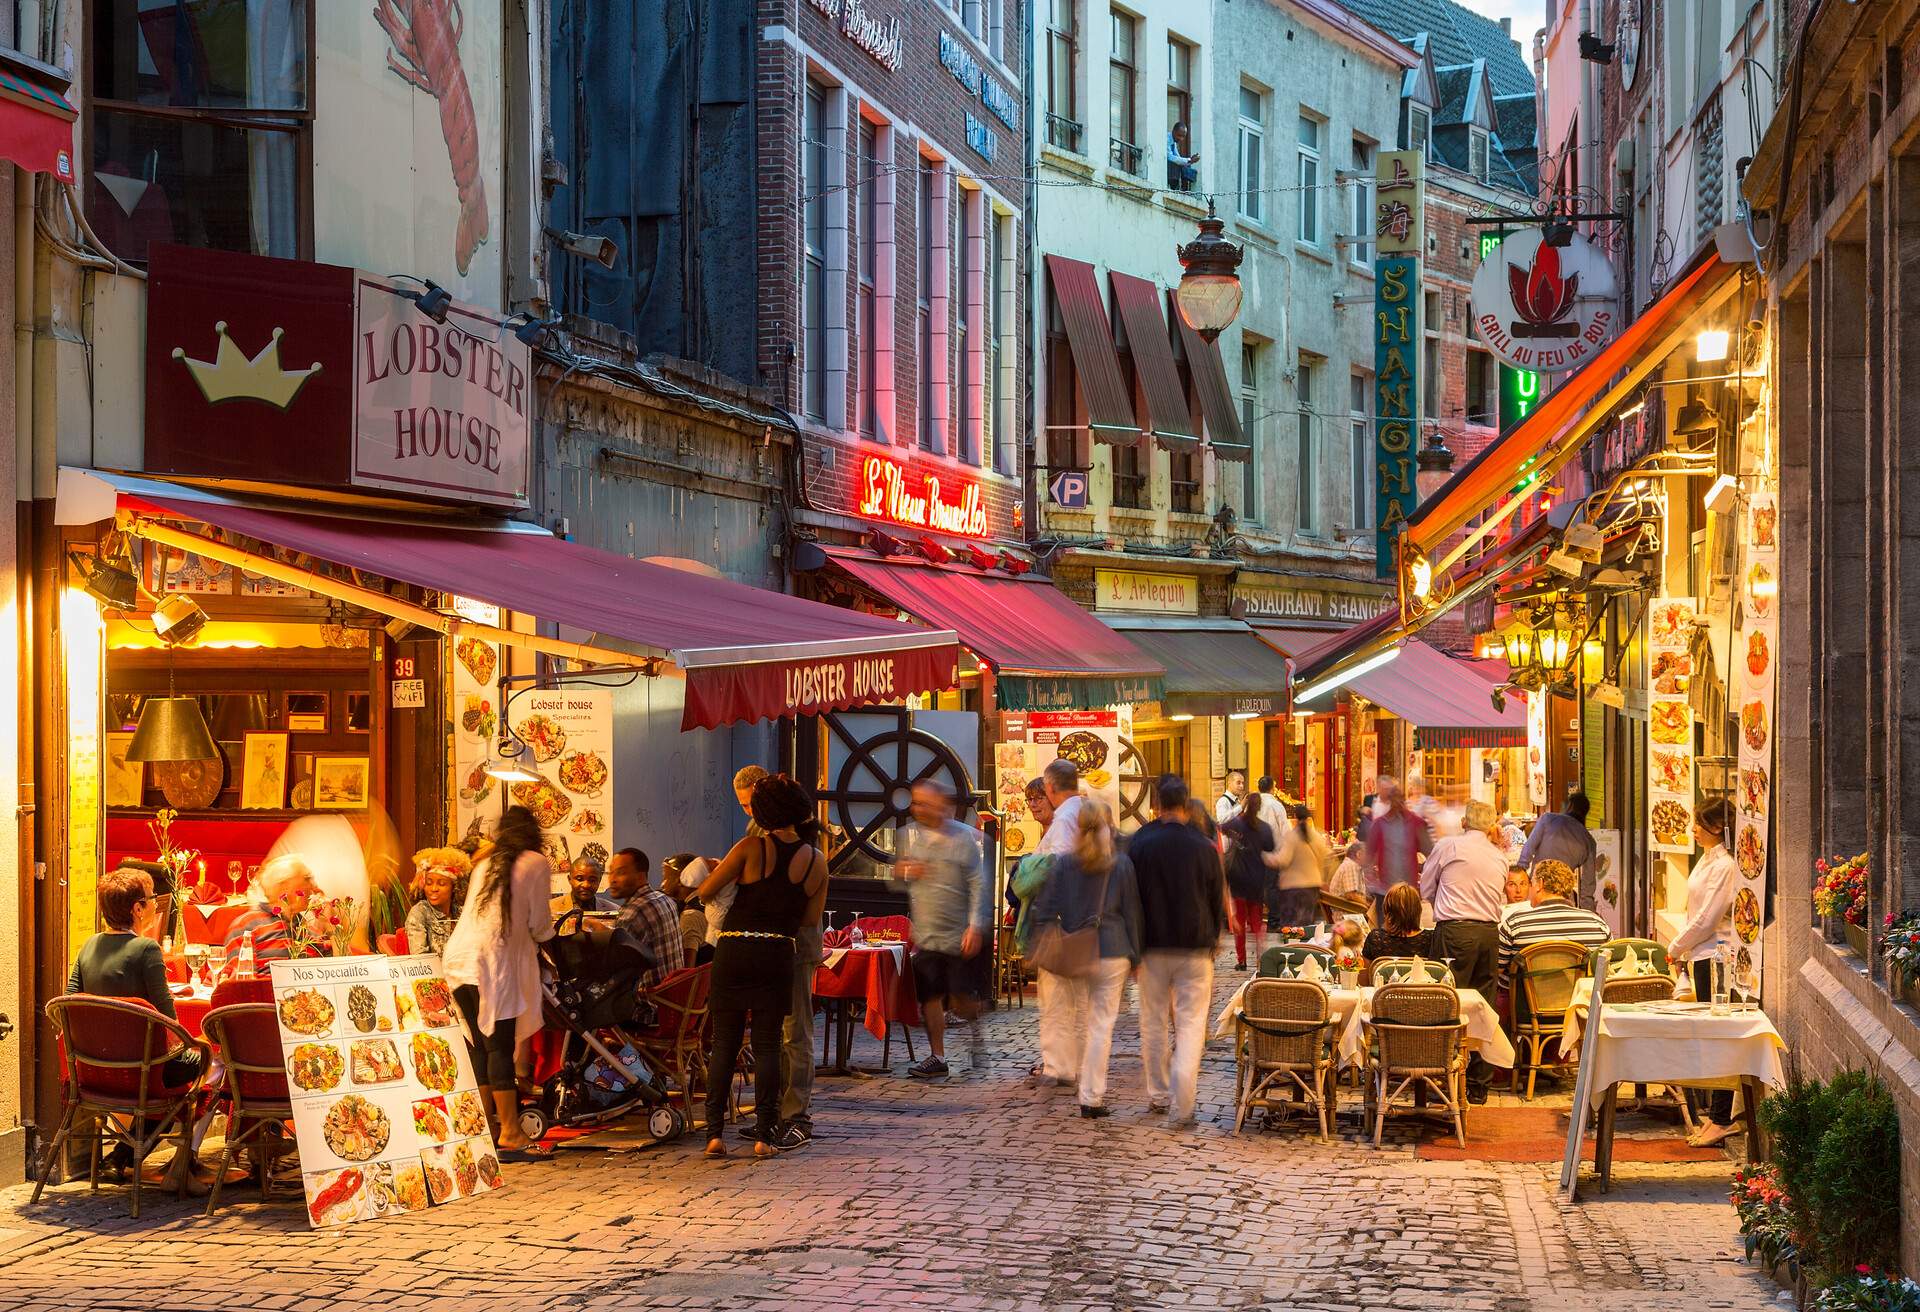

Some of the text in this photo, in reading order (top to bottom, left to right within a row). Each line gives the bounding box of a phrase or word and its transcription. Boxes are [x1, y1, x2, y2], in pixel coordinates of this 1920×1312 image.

[1377, 158, 1416, 243] 上海
[1480, 311, 1611, 367] GRILL AU FEU DE BOIS
[363, 323, 525, 417] LOBSTER
[394, 406, 501, 475] HOUSE
[860, 456, 884, 516] Le
[1063, 478, 1084, 504] P
[394, 681, 423, 691] FREE
[395, 658, 414, 677] 39
[785, 658, 895, 708] LOBSTER HOUSE
[531, 698, 563, 710] Lobster
[292, 967, 314, 981] Nos
[389, 963, 433, 979] os Viandes
